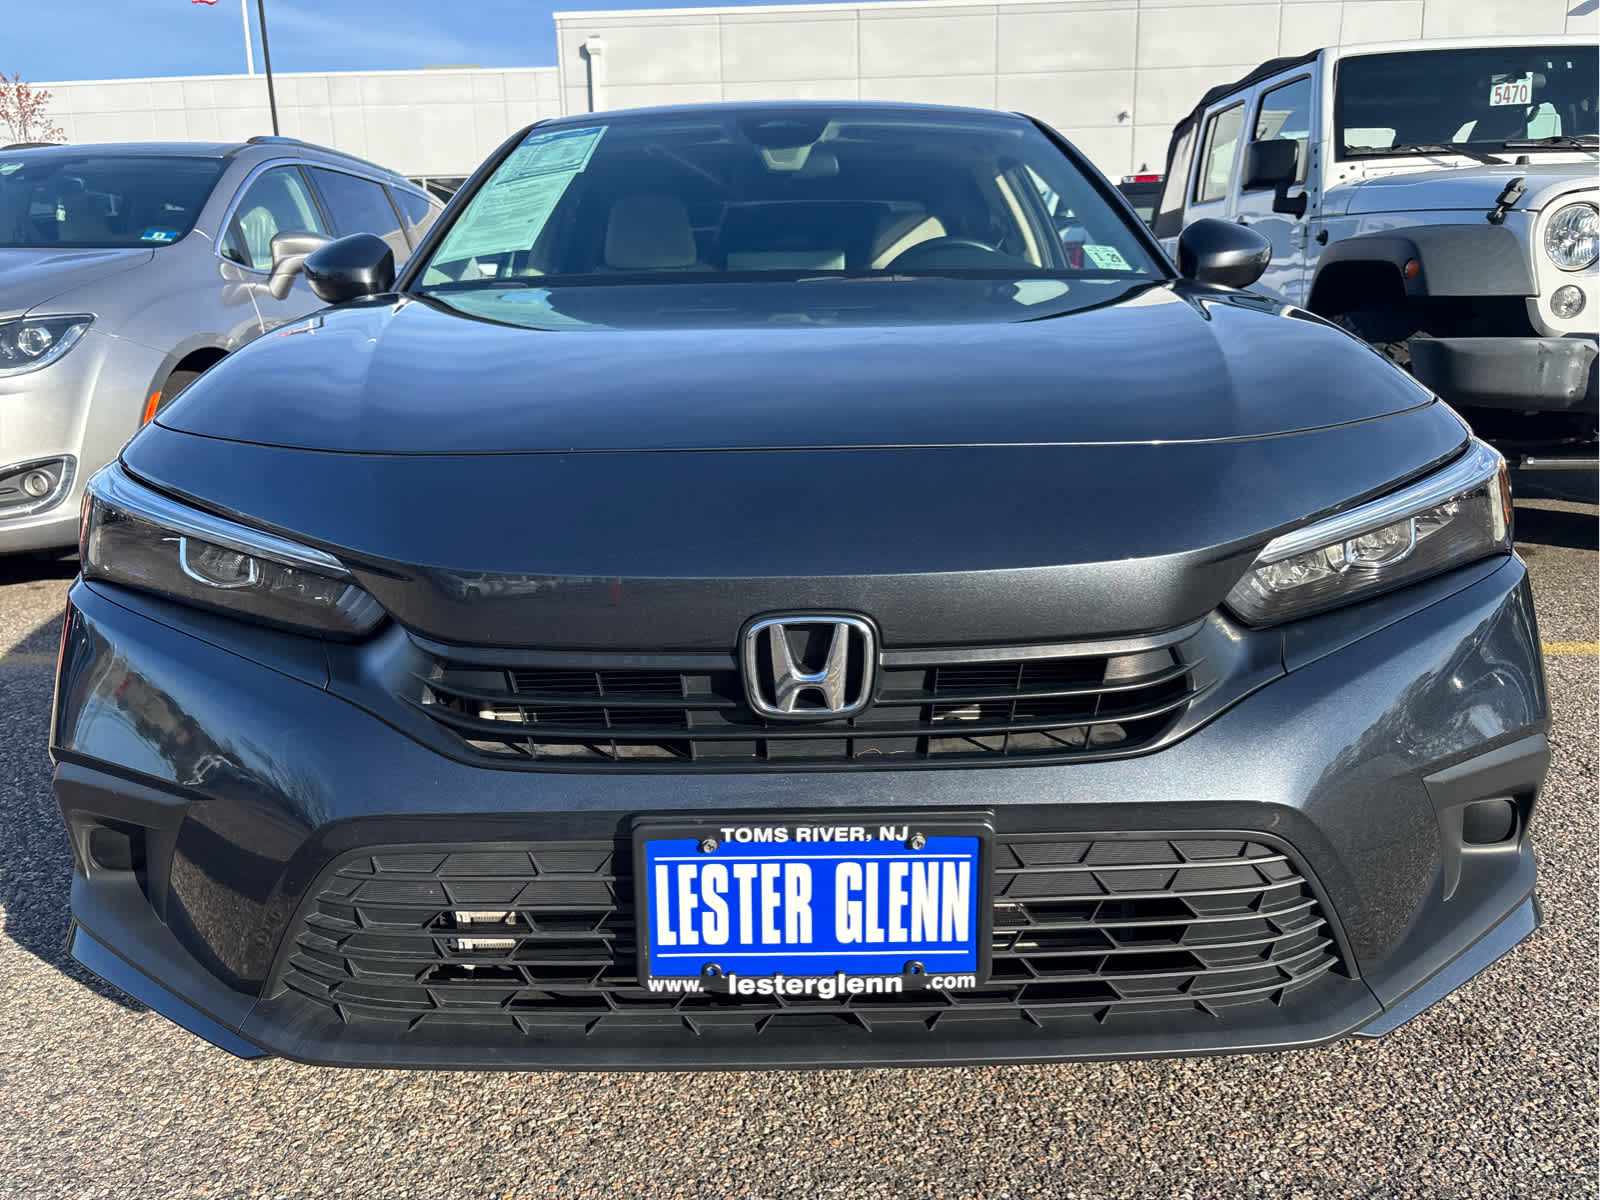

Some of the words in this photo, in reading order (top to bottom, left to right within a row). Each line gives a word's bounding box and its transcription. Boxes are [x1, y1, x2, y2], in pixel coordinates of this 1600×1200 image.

[1494, 84, 1528, 104] 5470
[720, 827, 789, 843] TOMS
[796, 826, 872, 843] RIVER,
[879, 826, 909, 842] NJ
[655, 863, 813, 946] LESTER
[835, 861, 971, 944] GLENN
[648, 979, 704, 993] www.
[728, 973, 903, 999] lesterglenn
[925, 975, 976, 990] .com
